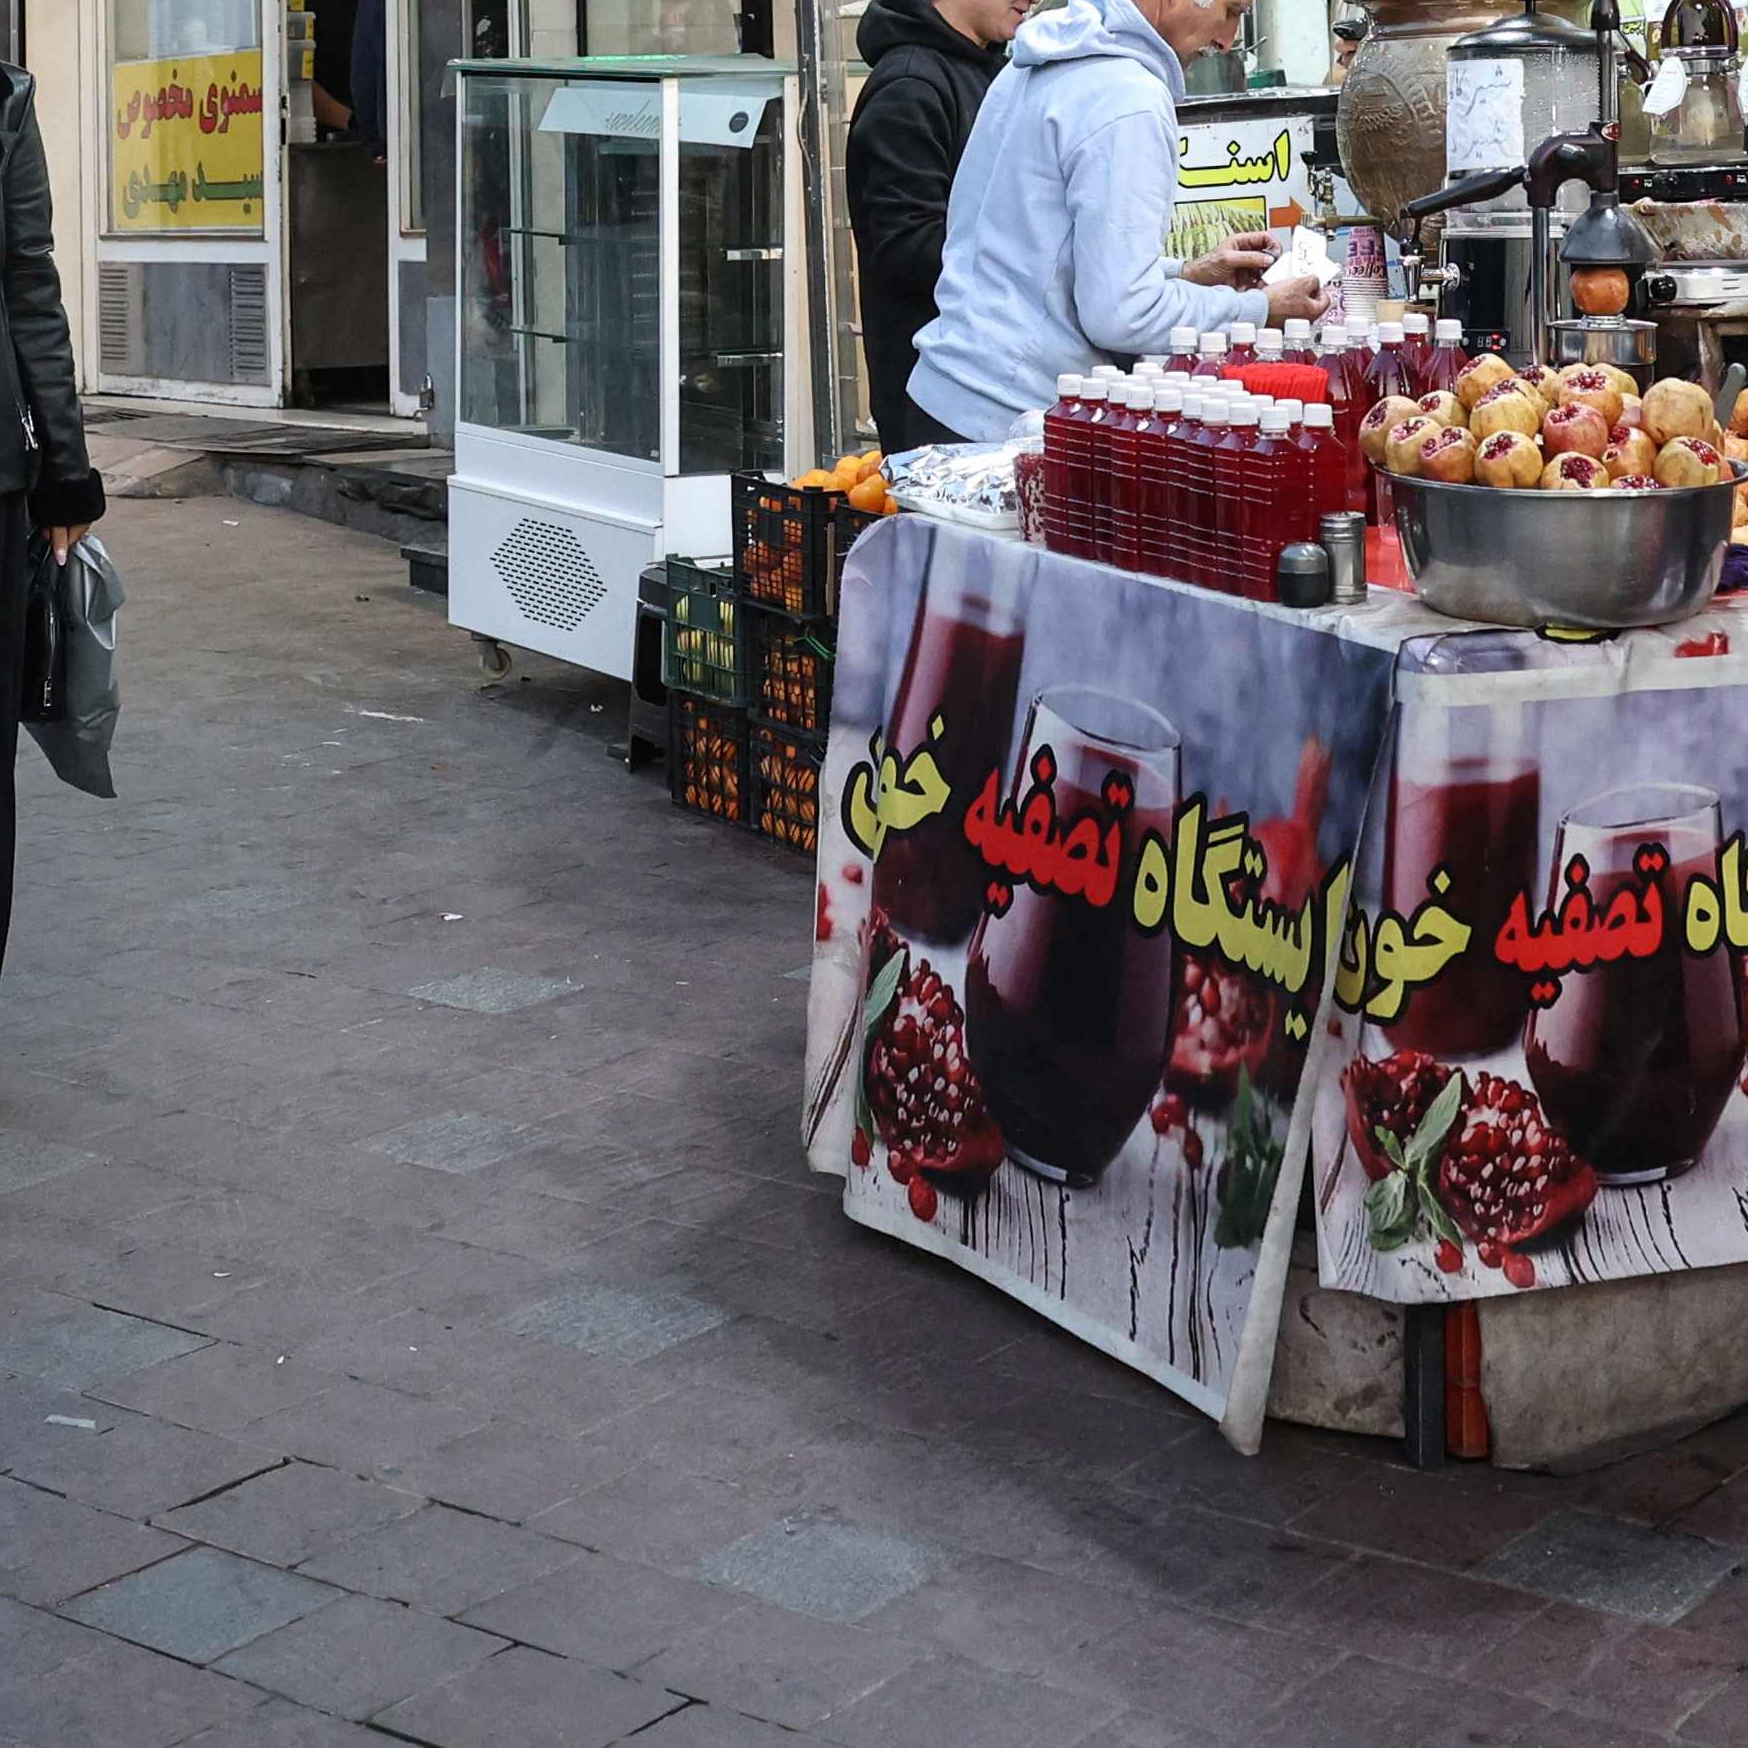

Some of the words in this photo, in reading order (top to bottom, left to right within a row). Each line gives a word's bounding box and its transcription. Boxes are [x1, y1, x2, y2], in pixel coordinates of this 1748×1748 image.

[117, 68, 194, 140] مخصوص
[1179, 128, 1292, 188] اسن
[123, 163, 188, 220] مهدی
[963, 744, 1132, 917] تصفیه
[1132, 794, 1357, 1042] ایستگاه
[1494, 844, 1669, 1006] تصفیه
